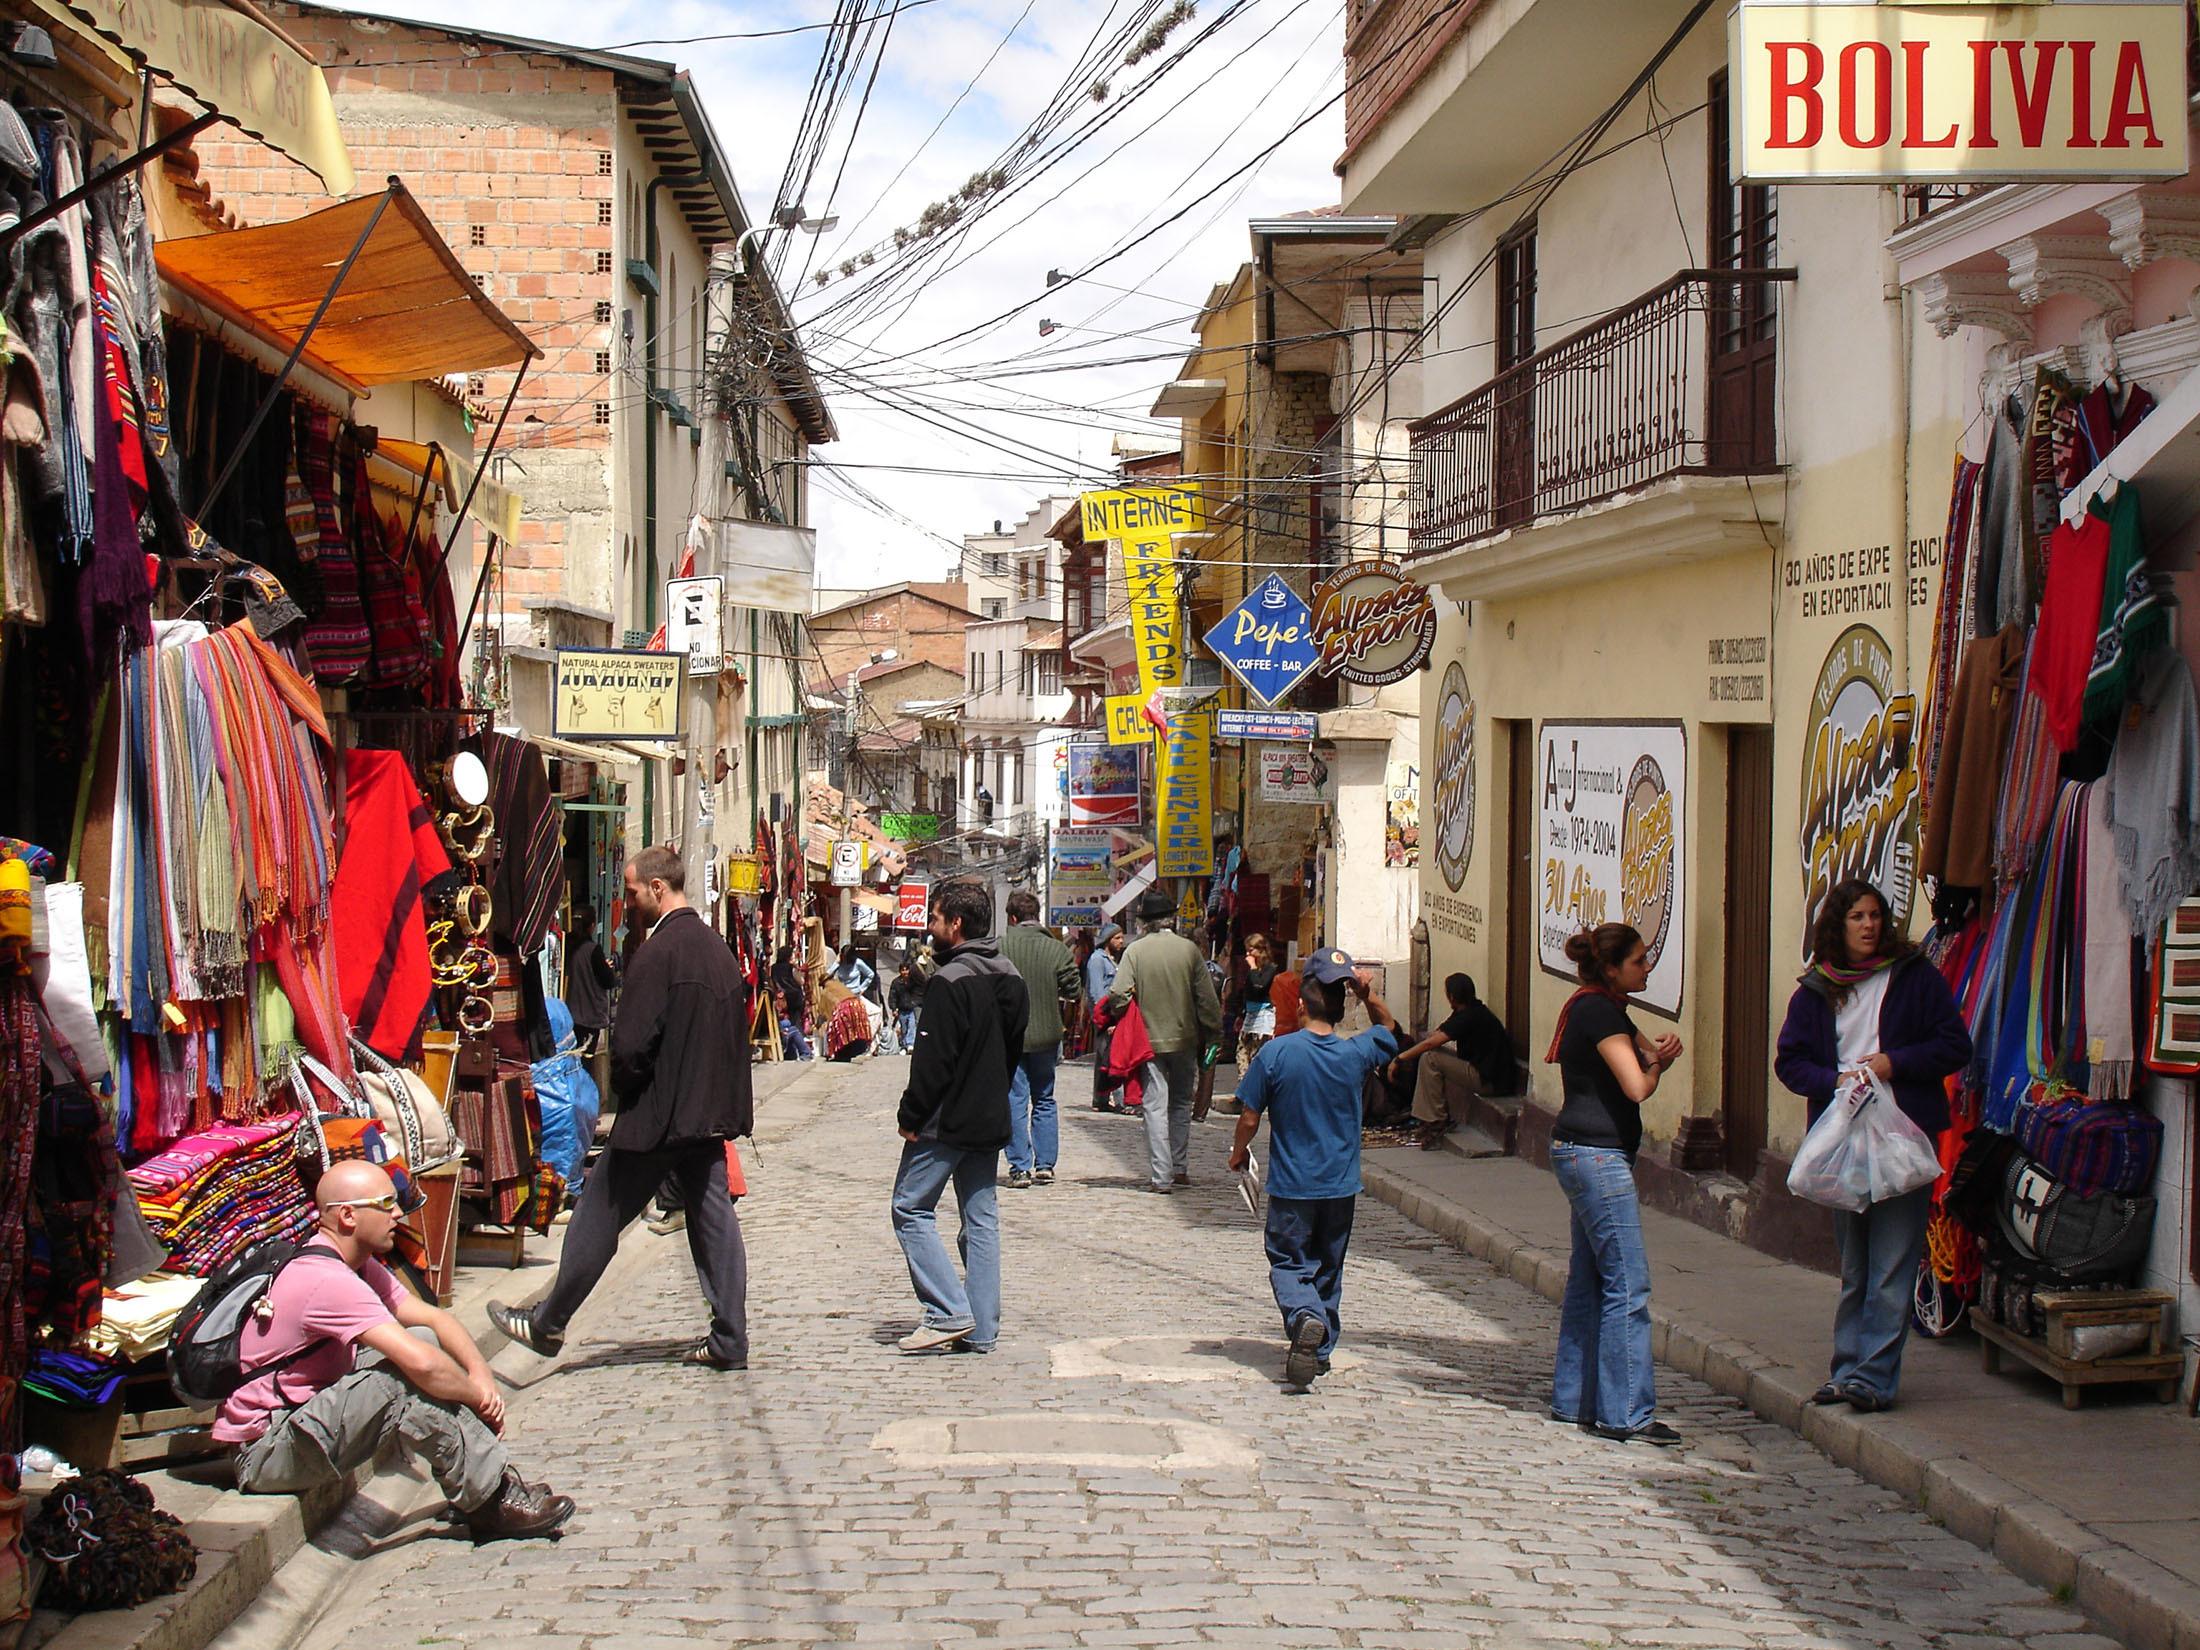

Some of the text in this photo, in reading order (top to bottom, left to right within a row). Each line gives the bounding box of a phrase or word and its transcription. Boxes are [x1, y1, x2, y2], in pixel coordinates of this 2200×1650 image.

[1764, 40, 2164, 149] BOLIVIA
[1087, 491, 1197, 532] INTERNET
[1328, 564, 1362, 590] TEJIDOS
[1365, 563, 1377, 572] DE
[1785, 560, 1801, 587] 30
[1805, 553, 1835, 584] AÑOS
[1839, 551, 1855, 579] DE
[1135, 541, 1177, 680] FRIENDS
[1802, 591, 1817, 617] EN
[690, 642, 701, 653] NO
[562, 658, 675, 670] NATURAL ALPACA SWEATERS
[689, 655, 721, 669] CIONAR
[1237, 658, 1271, 671] COFFEE
[1282, 660, 1302, 672] BAR
[1341, 666, 1402, 684] KNITTED GOODS
[1818, 646, 1847, 711] TEJIDOS
[1853, 639, 1863, 666] DE
[568, 667, 667, 693] UYUNI
[1166, 717, 1202, 766] CALL
[1394, 788, 1408, 799] OF
[1616, 767, 1623, 796] &
[1166, 774, 1202, 848] CENTER
[1570, 815, 1616, 857] 1974-2004
[1545, 857, 1607, 926] 30 Años
[1446, 897, 1454, 915] DE
